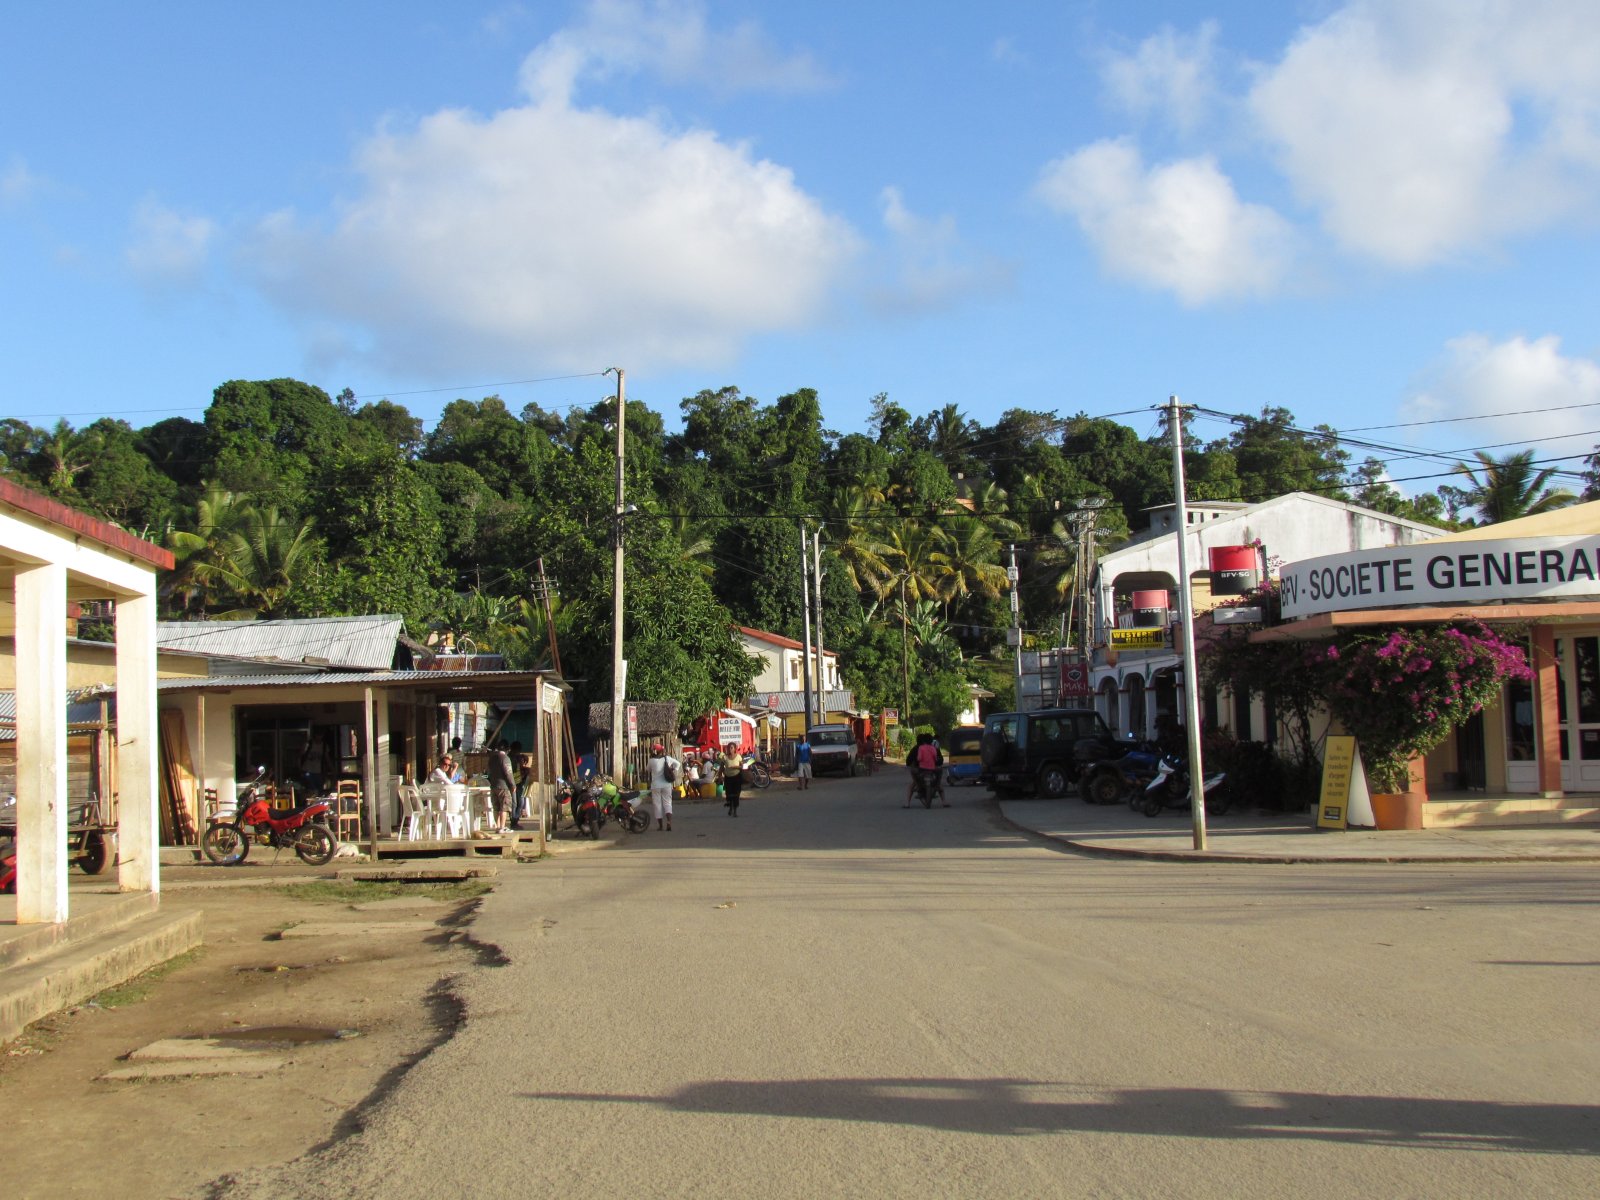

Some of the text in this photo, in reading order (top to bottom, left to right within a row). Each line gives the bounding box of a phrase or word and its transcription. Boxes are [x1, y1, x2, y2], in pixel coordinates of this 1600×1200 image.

[1281, 574, 1298, 607] BFV
[1309, 558, 1414, 600] SOCIETE
[1426, 548, 1600, 589] GENERA
[1112, 631, 1153, 639] WESTERN
